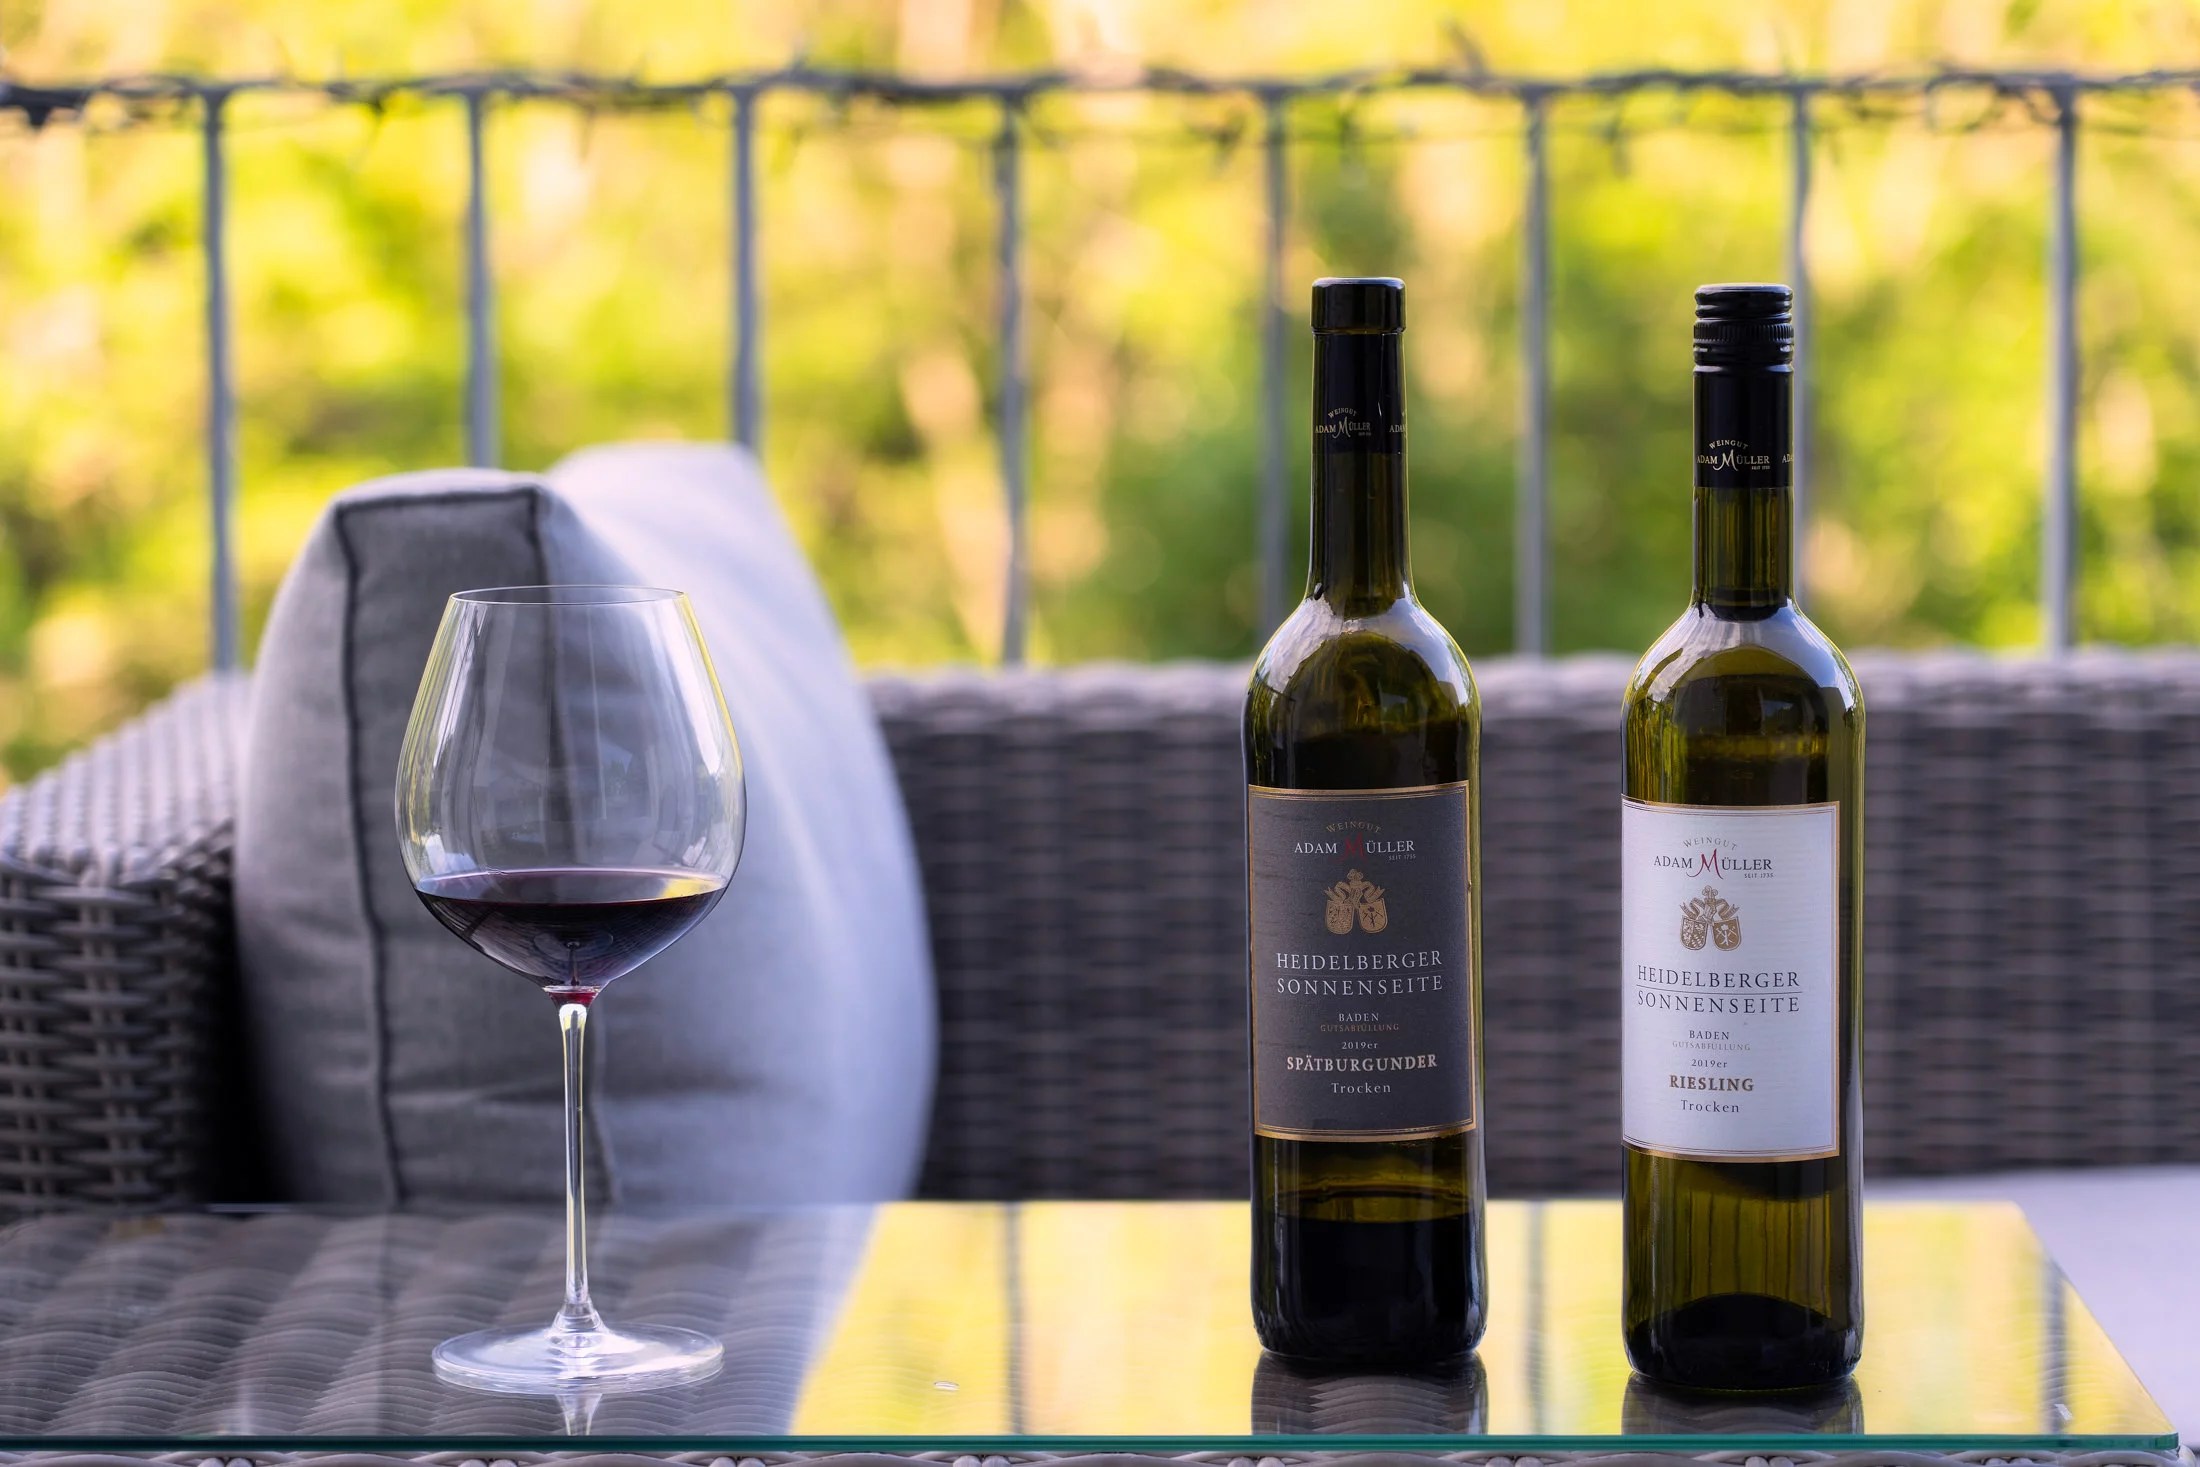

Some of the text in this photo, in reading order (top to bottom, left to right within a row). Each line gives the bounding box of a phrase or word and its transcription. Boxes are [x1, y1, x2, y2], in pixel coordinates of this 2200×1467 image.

[1328, 407, 1357, 418] WEINGUT
[1315, 424, 1336, 433] ADAM
[1709, 439, 1748, 449] WEINGUT
[1696, 449, 1770, 471] ADAM MÜLLER
[1326, 821, 1382, 833] WEINGUT
[1294, 831, 1416, 864] ADAM MÜLLER
[1682, 836, 1738, 851] WEINGUT
[1653, 848, 1773, 880] ADAM MÜLLER
[1276, 950, 1442, 970] HEIDELBERGER
[1637, 964, 1800, 988] HEIDELBERGER
[1277, 975, 1443, 996] SONNENSEITE
[1637, 990, 1800, 1014] SONNENSEITE
[1338, 1012, 1380, 1022] BADEN
[1688, 1030, 1730, 1040] BADEN
[1341, 1041, 1378, 1050] 2019er
[1287, 1054, 1438, 1072] SPÄTBURGUNDER
[1691, 1058, 1728, 1068] 2019er
[1331, 1082, 1391, 1094] Trocken
[1669, 1074, 1754, 1092] RIESLING
[1680, 1099, 1740, 1113] Trocken
